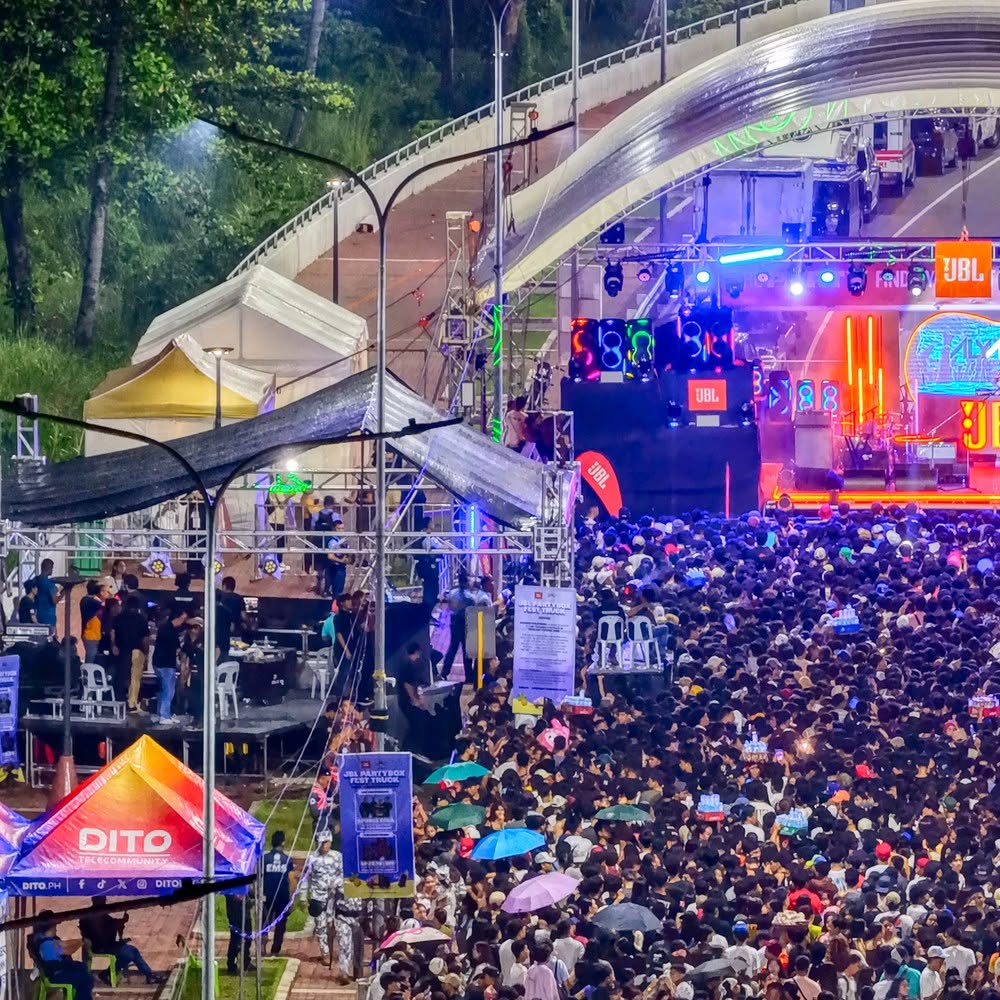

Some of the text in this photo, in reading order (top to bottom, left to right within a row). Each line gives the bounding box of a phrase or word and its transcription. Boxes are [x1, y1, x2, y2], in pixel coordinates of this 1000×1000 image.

[944, 257, 985, 282] JBL
[695, 387, 720, 403] JBL
[588, 461, 610, 489] JBL
[79, 828, 173, 853] DITO
[78, 855, 169, 865] TELECOMMUNITY
[22, 882, 61, 890] DITO.PH
